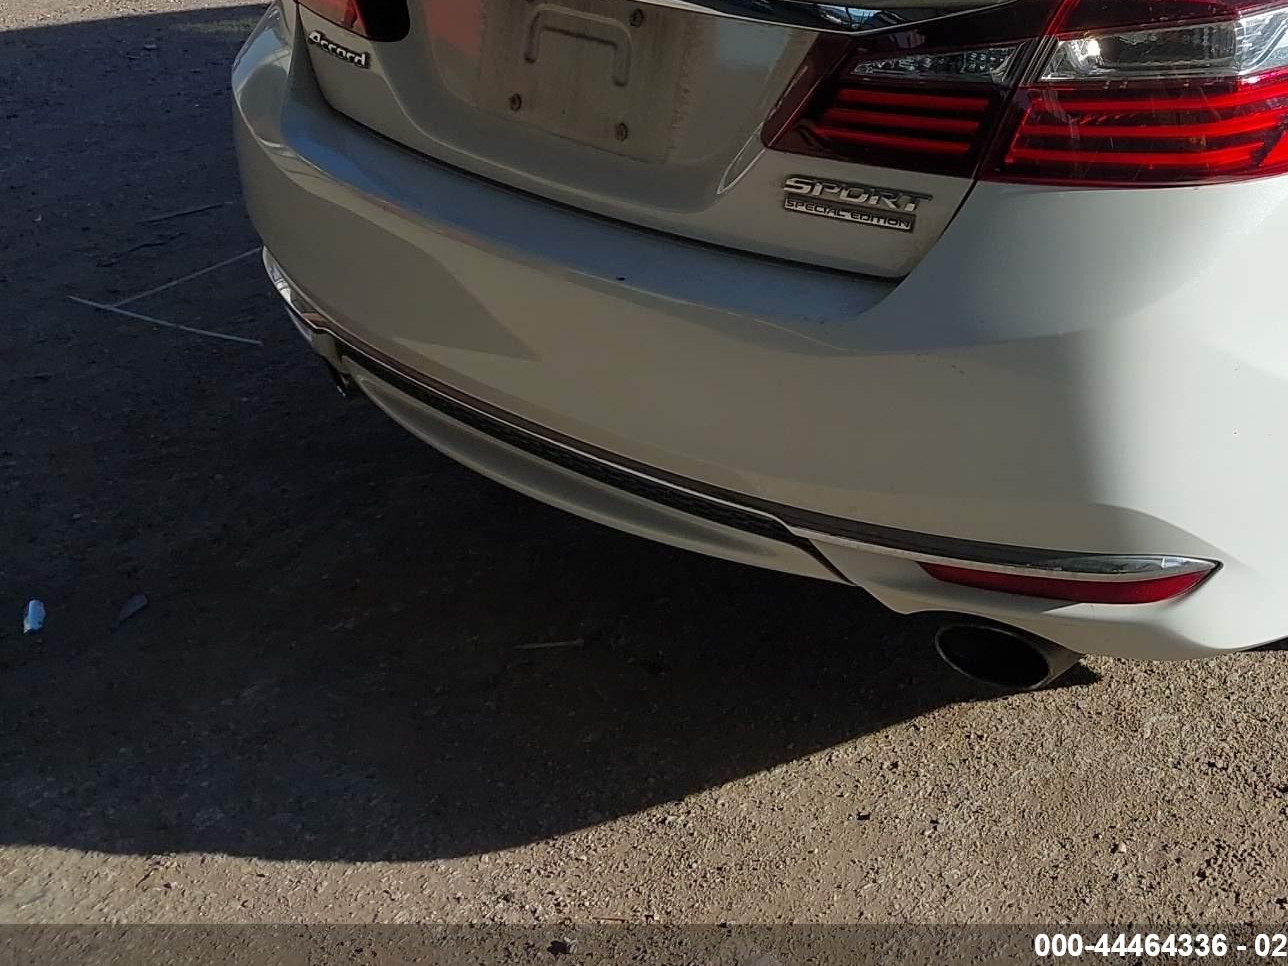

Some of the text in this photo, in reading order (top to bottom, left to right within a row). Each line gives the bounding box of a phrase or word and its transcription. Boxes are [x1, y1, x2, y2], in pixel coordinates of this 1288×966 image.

[308, 30, 368, 68] Accord
[784, 176, 933, 213] SPORT
[785, 199, 911, 229] SPECIAL EDITION
